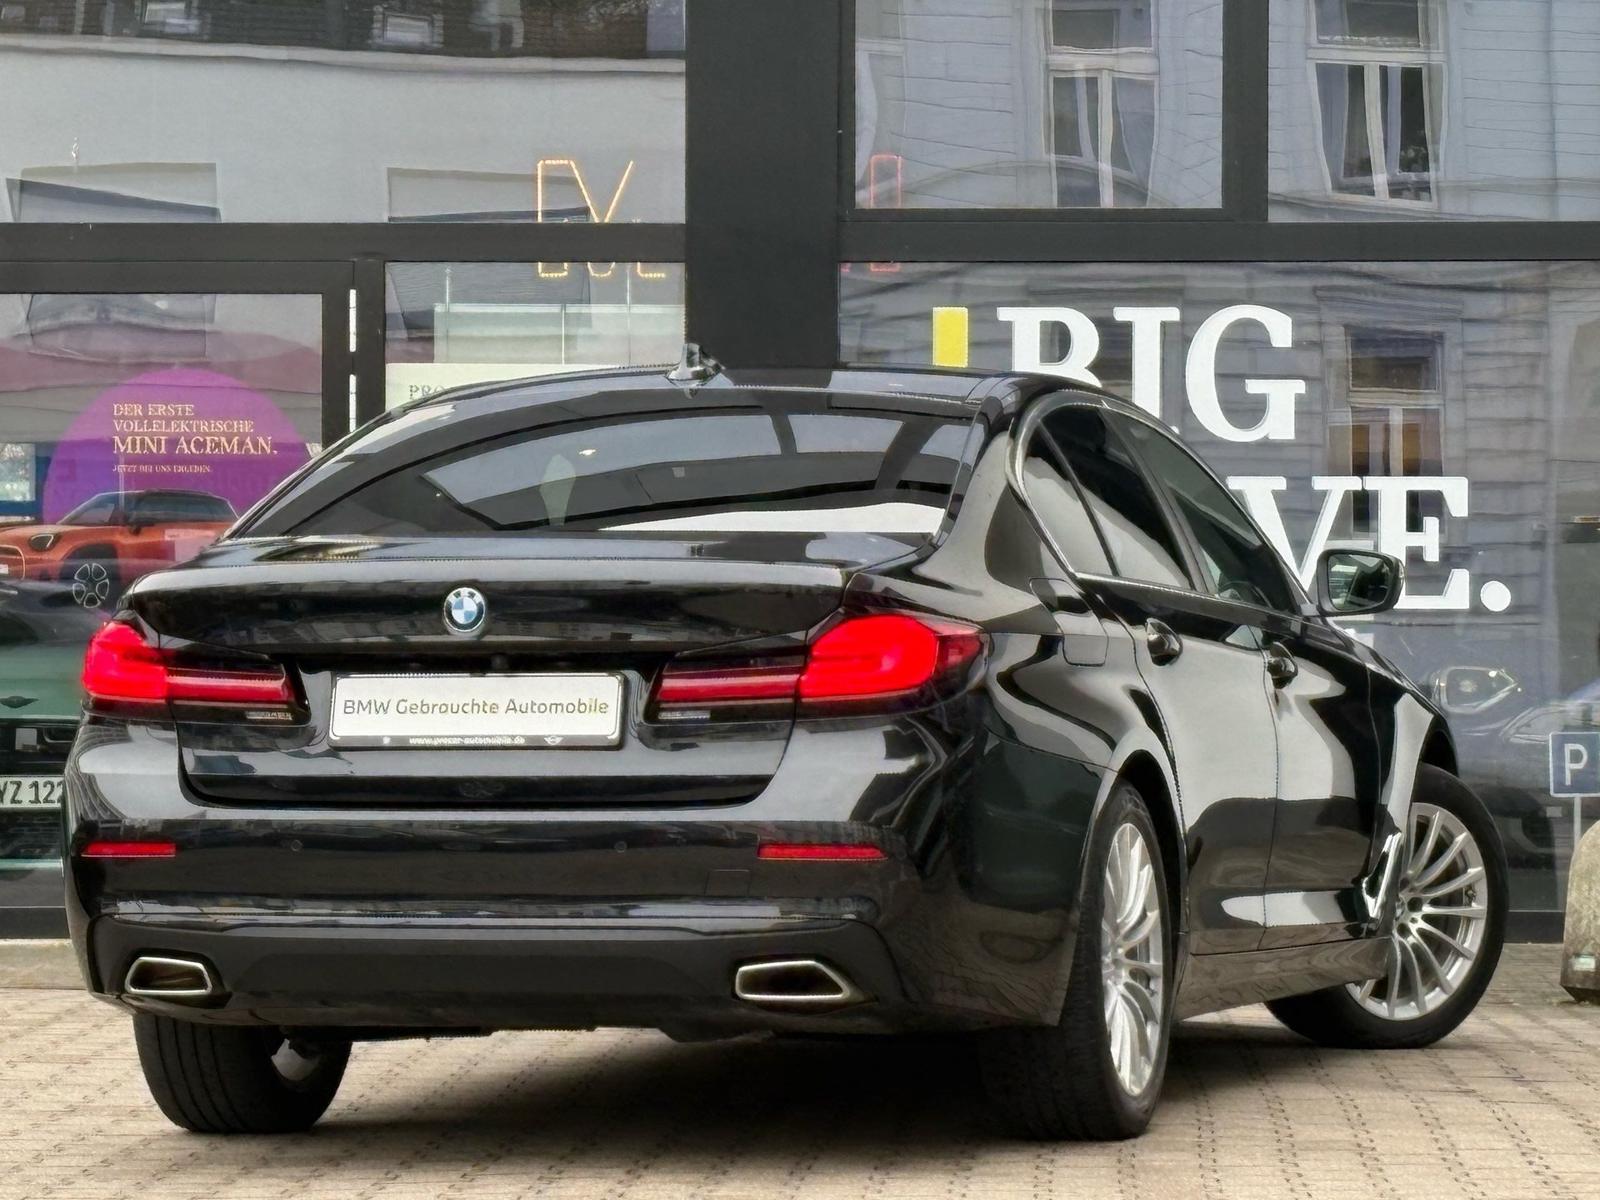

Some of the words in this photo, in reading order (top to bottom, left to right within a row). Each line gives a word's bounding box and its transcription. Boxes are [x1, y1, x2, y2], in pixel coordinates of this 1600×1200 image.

[113, 403, 143, 416] DER
[148, 403, 195, 416] ERSTE
[113, 419, 254, 433] VOLLELEKTRISCHE
[113, 435, 168, 454] MINI
[175, 435, 278, 455] ACEMAN.
[343, 699, 391, 715] BMW
[396, 698, 500, 715] Gebrauchte
[504, 697, 609, 715] Automobile
[1564, 743, 1588, 786] P
